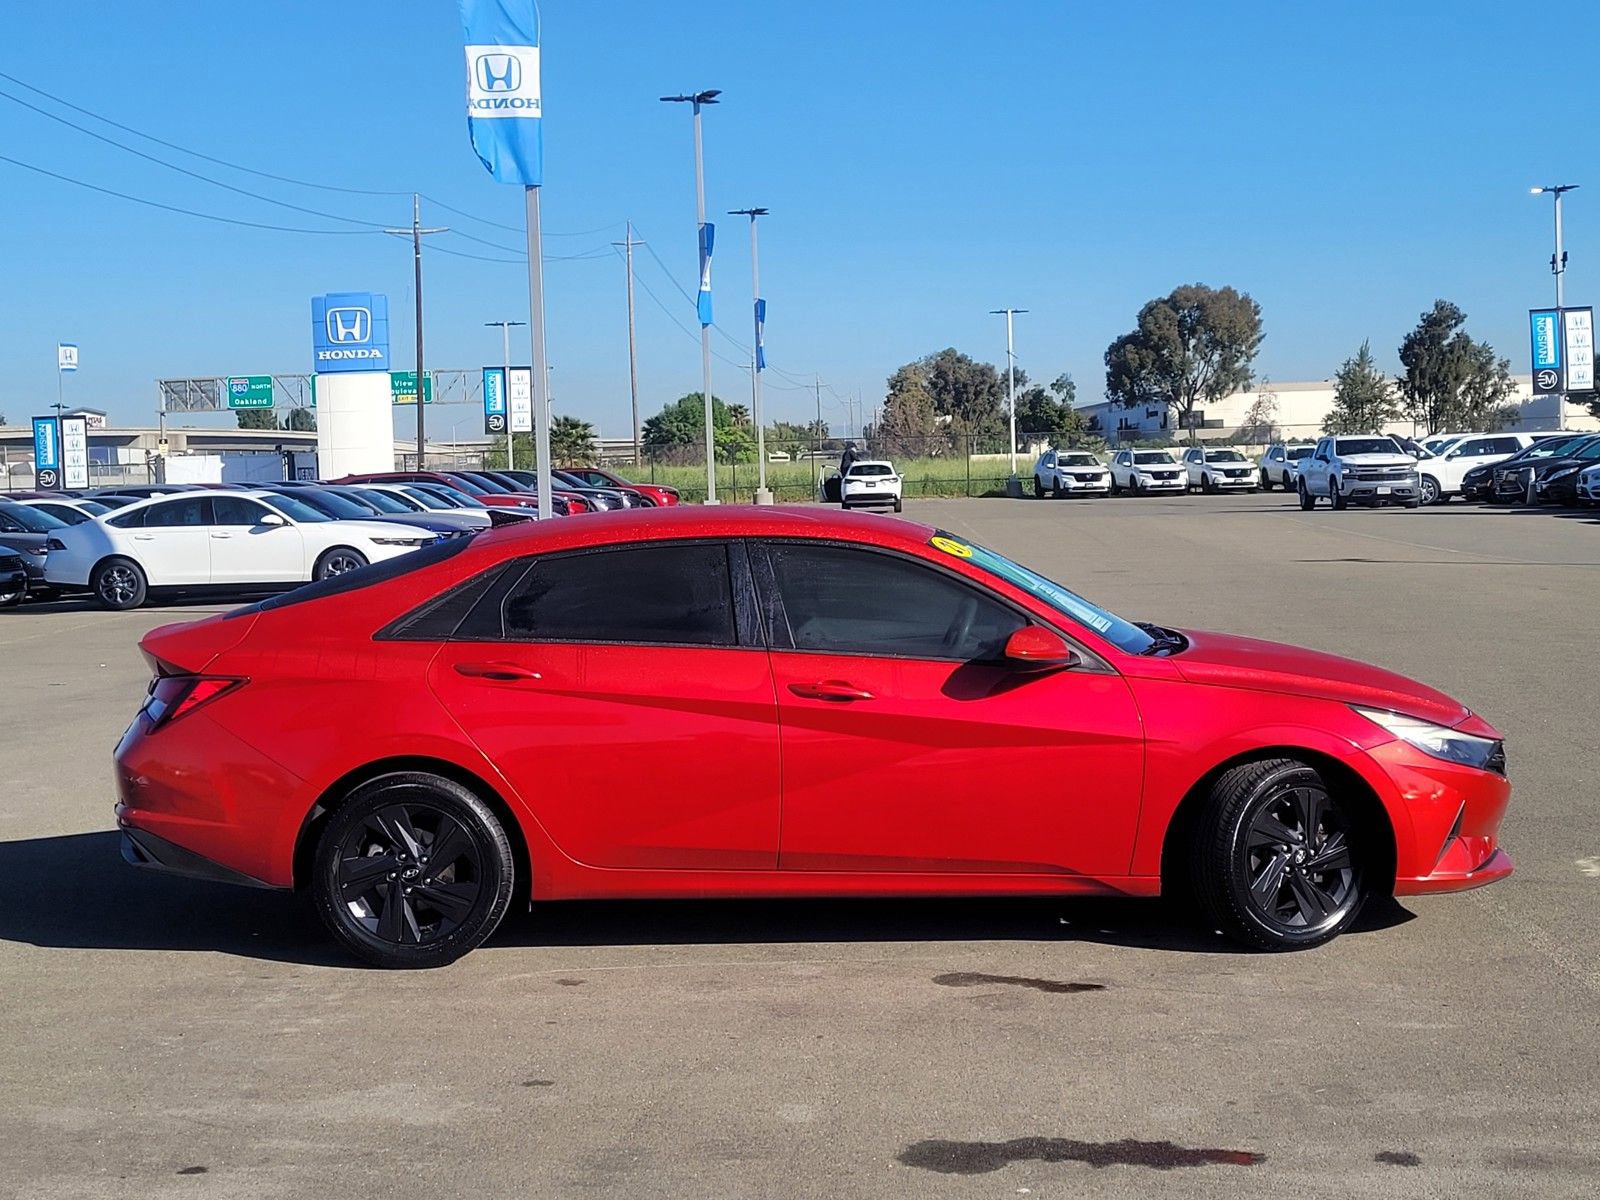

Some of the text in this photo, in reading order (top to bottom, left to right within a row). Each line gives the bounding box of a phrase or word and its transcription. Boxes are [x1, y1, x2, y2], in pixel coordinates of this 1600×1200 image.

[1536, 317, 1547, 365] ENVISION
[318, 349, 383, 360] HONDA
[232, 384, 248, 392] 880
[38, 423, 48, 465] ENVISION
